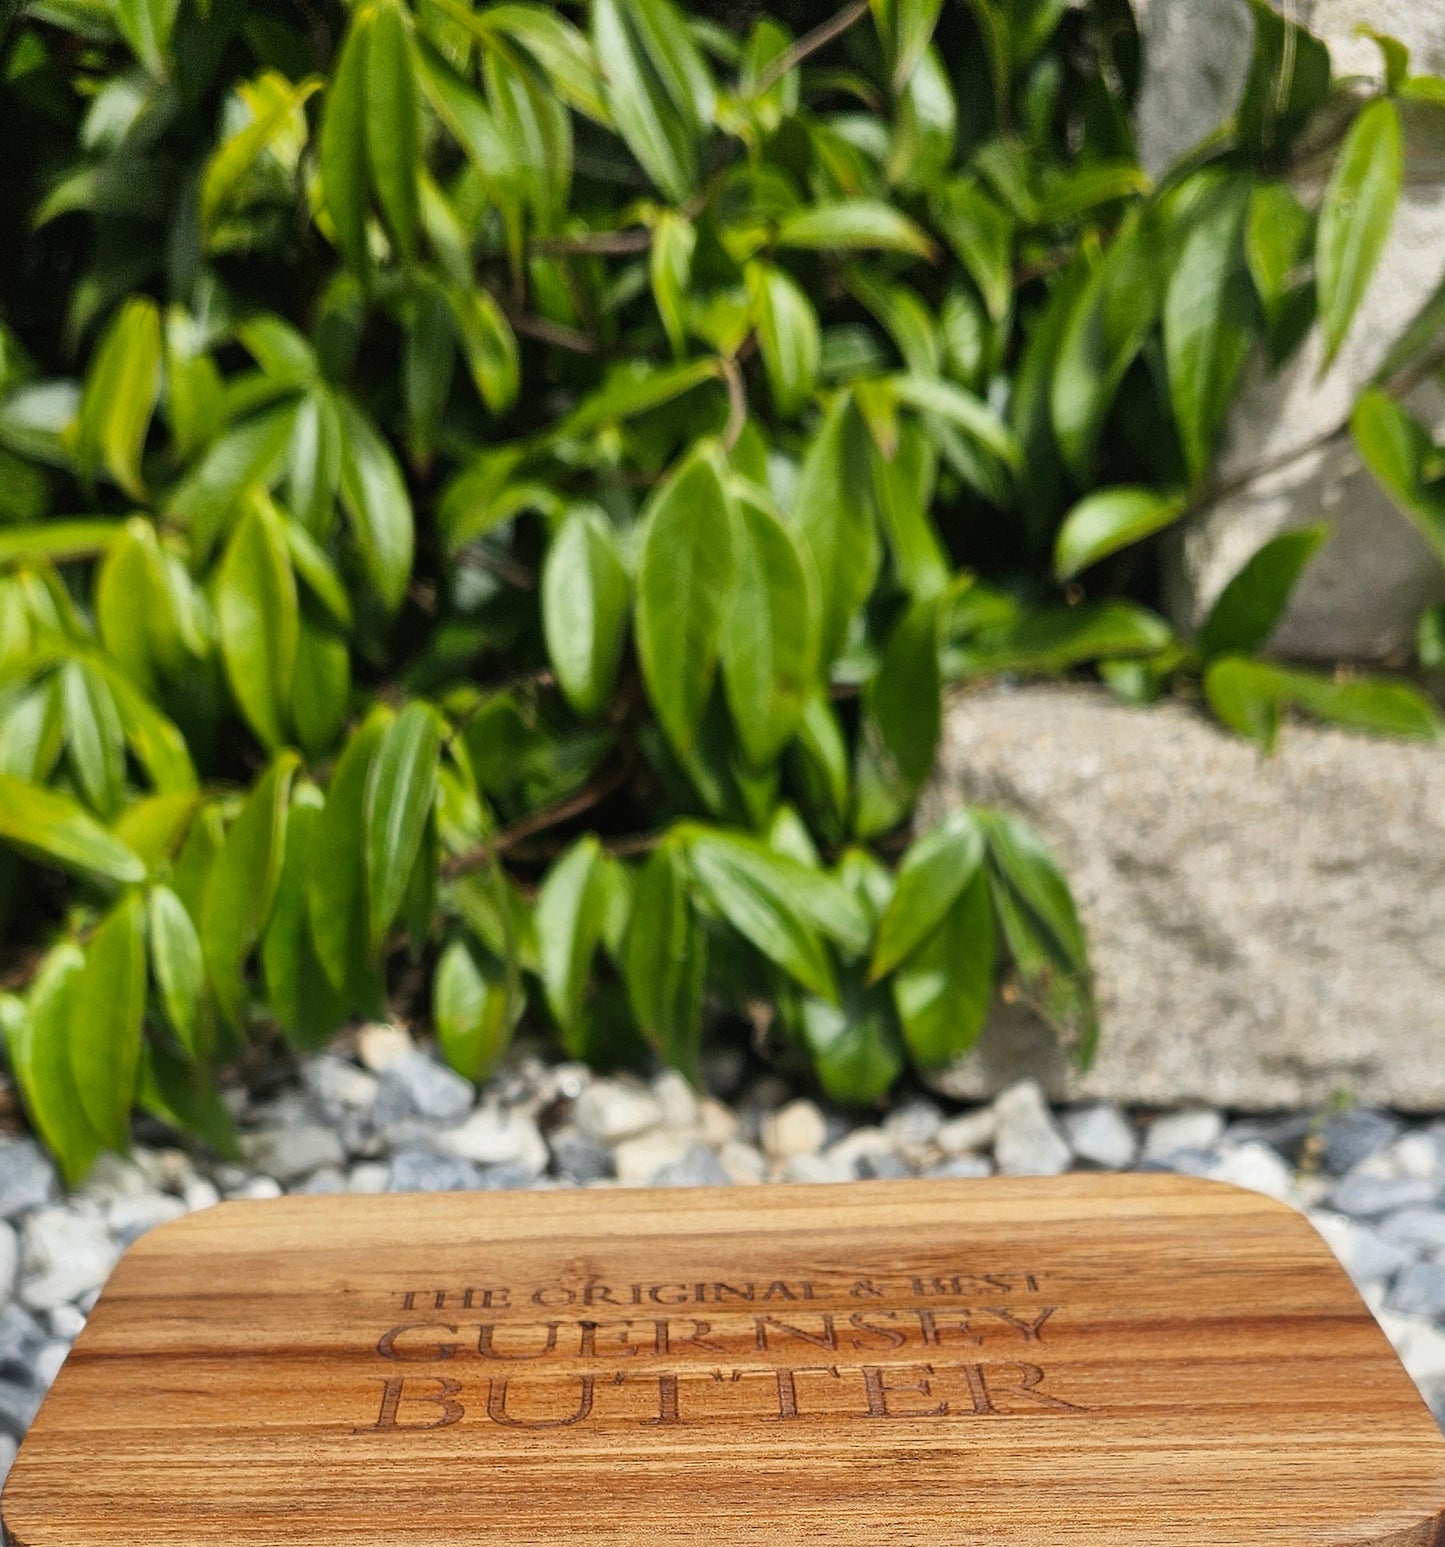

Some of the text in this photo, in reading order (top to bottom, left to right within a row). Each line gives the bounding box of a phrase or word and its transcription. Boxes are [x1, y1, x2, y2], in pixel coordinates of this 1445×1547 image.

[393, 1272, 1049, 1311] THE ORIGINAL & BEST
[376, 1306, 1062, 1363] GUERNSEY
[353, 1361, 1098, 1433] BUTTER
